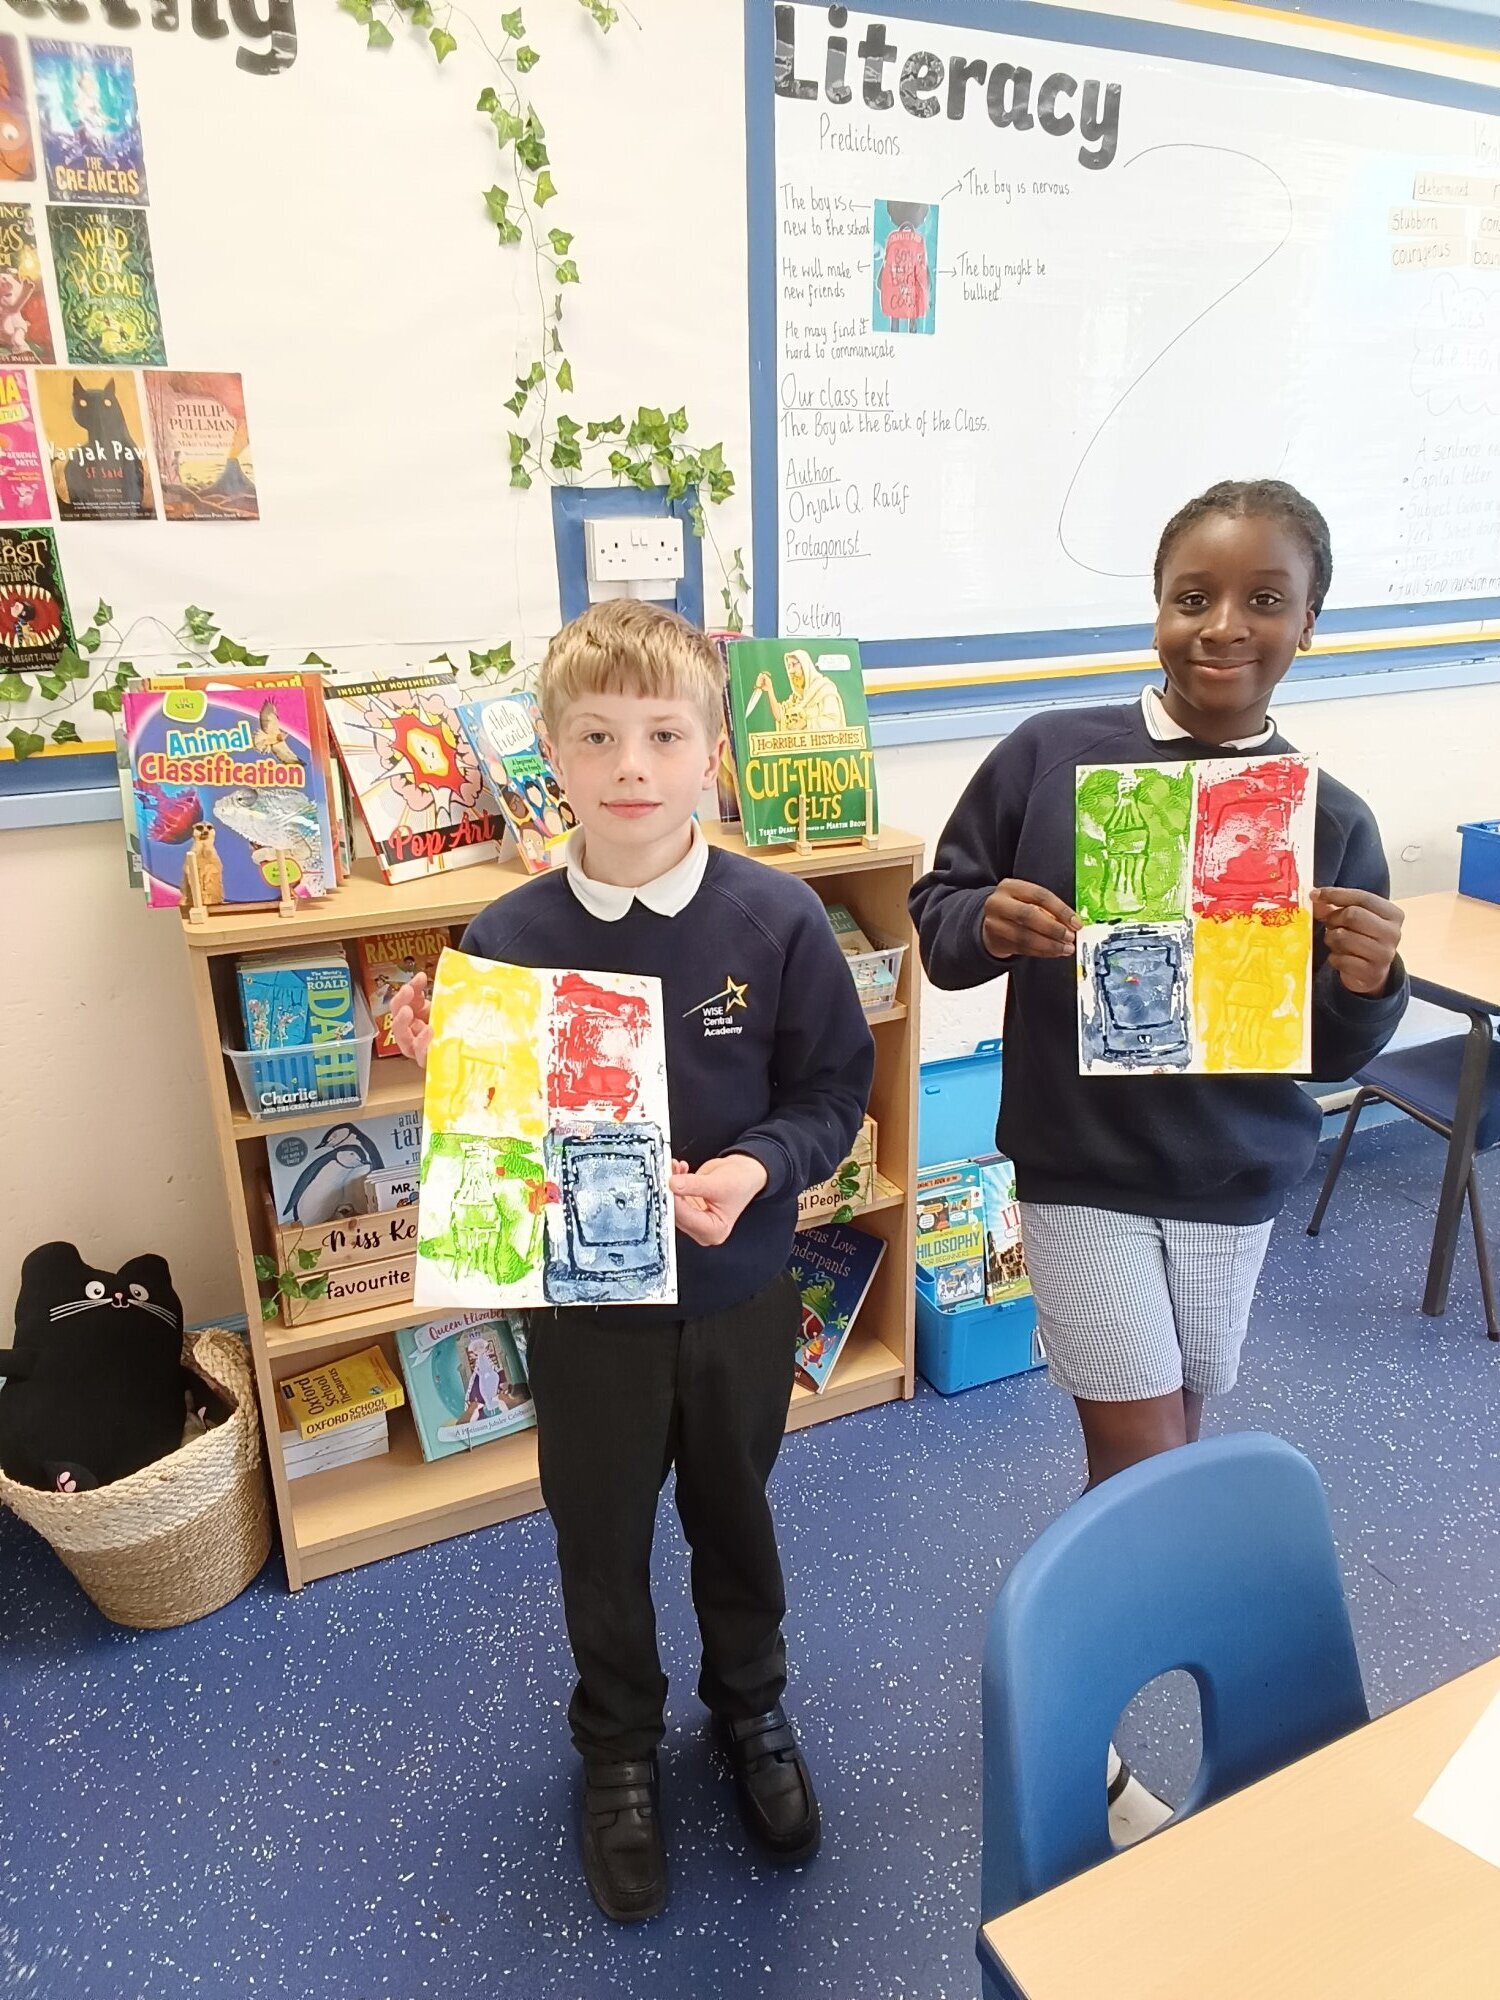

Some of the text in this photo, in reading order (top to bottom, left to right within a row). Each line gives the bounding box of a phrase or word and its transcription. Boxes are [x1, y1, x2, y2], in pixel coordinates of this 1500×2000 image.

[774, 4, 1122, 171] Literacy
[85, 156, 103, 170] THE
[55, 166, 140, 195] CREAKERS
[962, 168, 990, 196] The
[994, 170, 1012, 205] boy
[1018, 178, 1028, 196] is
[780, 183, 847, 219] The boy is
[75, 226, 129, 251] WILD
[783, 218, 871, 237] new to the school
[71, 250, 132, 275] WAY
[782, 257, 853, 280] He will make
[957, 251, 1047, 291] The boy might be
[68, 270, 144, 300] HOME
[783, 280, 846, 308] new friends
[785, 318, 869, 346] He may find it
[785, 342, 897, 361] hard to communicate
[781, 372, 891, 408] Our class text
[169, 418, 236, 432] PULLMAN
[177, 404, 225, 418] PHILIP
[781, 408, 991, 446] The Boy at the Back of the Class.
[111, 440, 148, 461] Paw
[1414, 436, 1427, 463] A
[86, 467, 124, 479] SF Said
[788, 488, 840, 524] Onjali
[0, 539, 48, 568] AST
[786, 529, 860, 570] Protagonist
[786, 603, 842, 637] Setting
[337, 676, 441, 698] INSIDE ART MOVEMENTS
[489, 705, 516, 731] Hello
[167, 721, 252, 760] Animal
[491, 713, 534, 752] French!
[757, 733, 861, 751] HORRIBLE HISTORIES
[138, 751, 307, 788] Classification
[745, 751, 874, 800] CUT-THROAT
[784, 794, 842, 825] CELTS
[388, 809, 496, 864] Pop Art
[779, 826, 797, 834] DEARY
[826, 821, 849, 830] MARTIN
[849, 820, 866, 828] BROW
[364, 933, 448, 963] RASHFORD
[306, 979, 349, 990] ROALD
[702, 1006, 724, 1017] WISE
[703, 1015, 733, 1026] Central
[307, 988, 358, 1092] DAHL
[704, 1025, 743, 1037] Academy
[260, 1087, 318, 1106] Charlie
[263, 1107, 276, 1115] AND
[289, 1103, 310, 1111] GREAT
[329, 1096, 360, 1106] ELEVATOR
[398, 1110, 419, 1128] and
[391, 1183, 414, 1195] MR.
[390, 1218, 417, 1242] Ke
[831, 1229, 857, 1256] Love
[916, 1230, 981, 1260] HILOSOPHY
[792, 1241, 851, 1278] nderpants
[327, 1270, 411, 1300] favourite
[428, 1319, 462, 1340] Queen
[294, 1376, 326, 1416] Oxford
[313, 1375, 339, 1407] School
[328, 1367, 353, 1404] Thesaurus
[306, 1397, 387, 1435] OXFORD SCHOOL
[349, 1404, 388, 1422] THESAURUS
